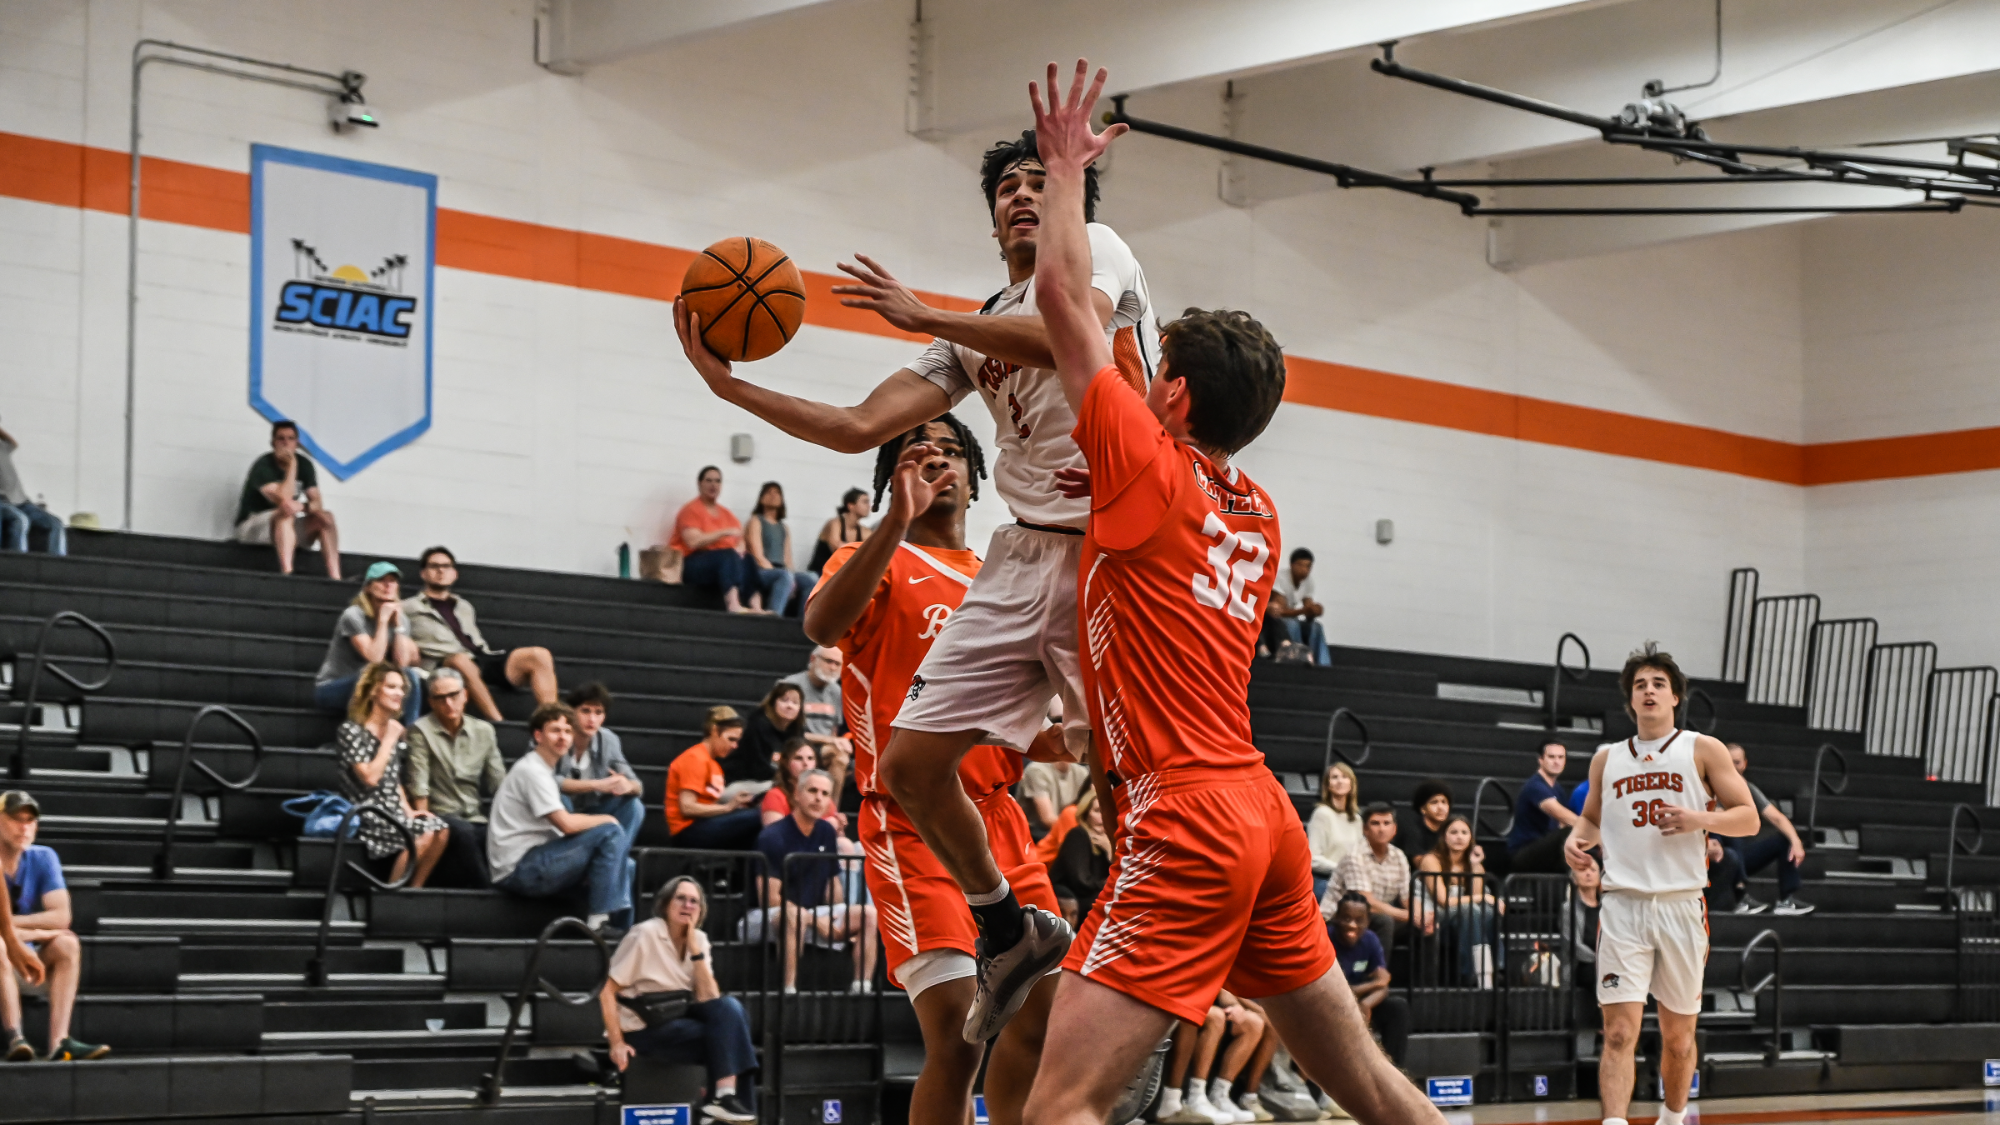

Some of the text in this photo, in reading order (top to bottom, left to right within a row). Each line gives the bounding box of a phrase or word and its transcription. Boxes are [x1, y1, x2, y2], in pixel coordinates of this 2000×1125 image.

[275, 281, 416, 338] SCIAC
[1191, 510, 1270, 624] 32
[1612, 771, 1684, 800] TIGERS
